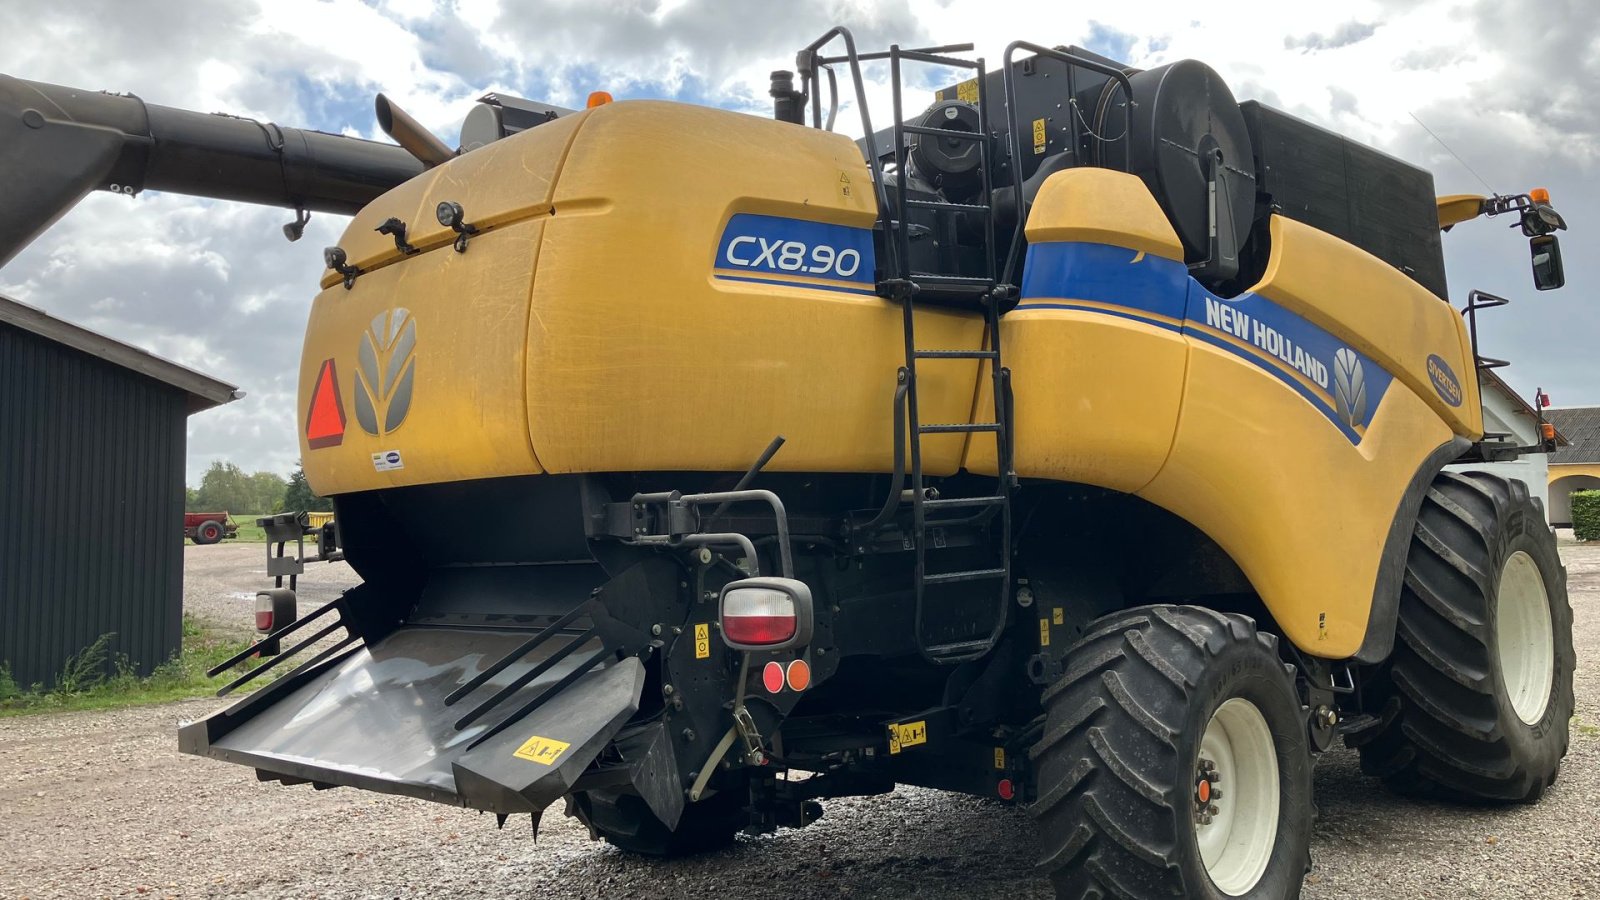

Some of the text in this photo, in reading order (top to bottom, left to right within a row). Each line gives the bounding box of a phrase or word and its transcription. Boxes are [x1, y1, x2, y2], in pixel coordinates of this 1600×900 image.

[727, 236, 860, 276] CX8.90
[1206, 297, 1328, 389] NEW HOLLAND
[1428, 359, 1460, 402] SIVERTSEN
